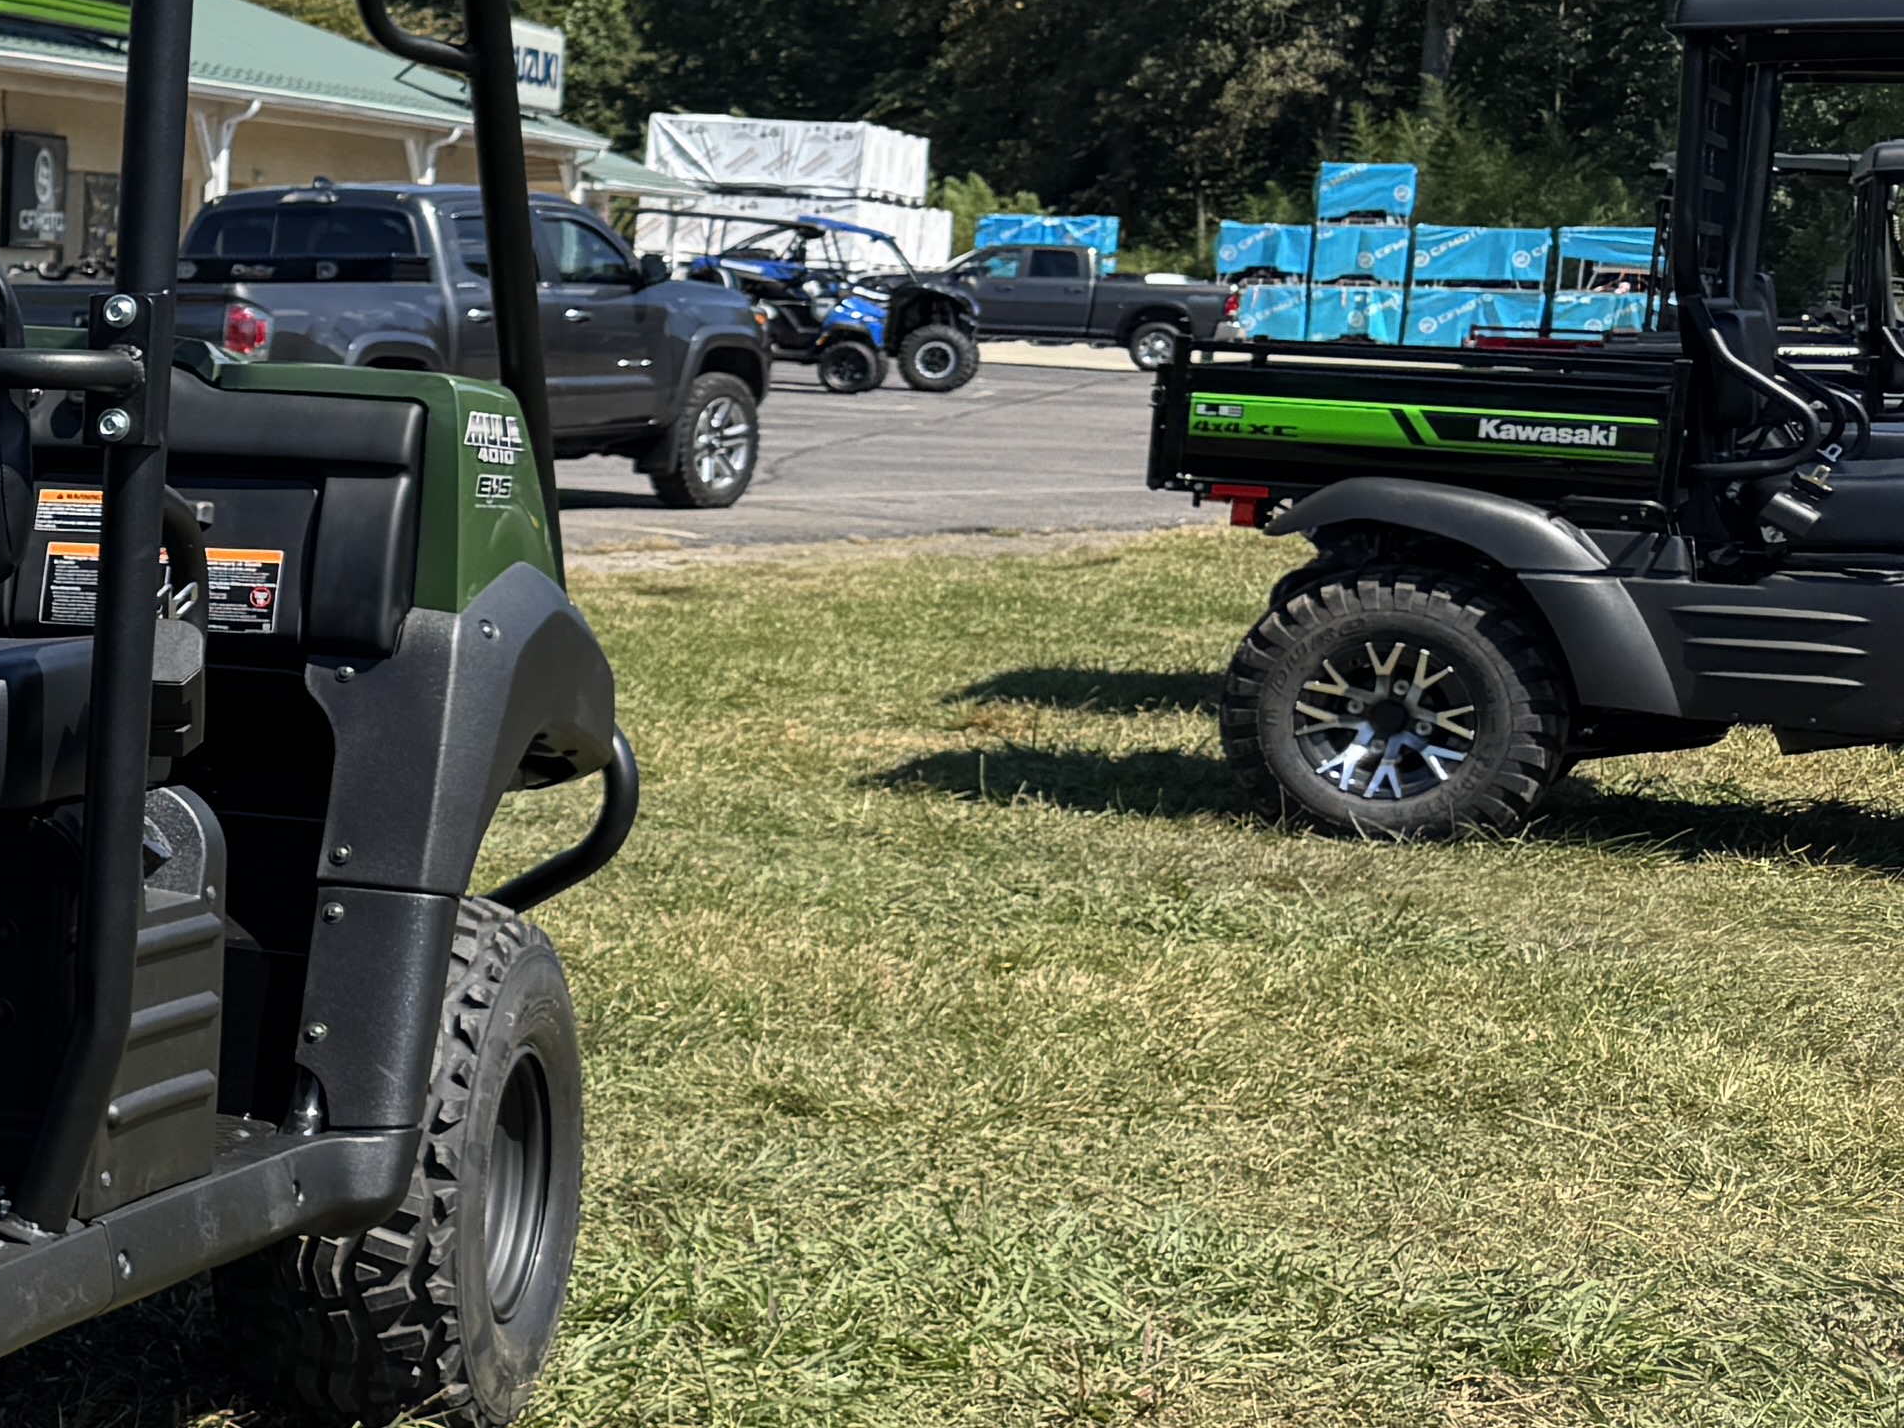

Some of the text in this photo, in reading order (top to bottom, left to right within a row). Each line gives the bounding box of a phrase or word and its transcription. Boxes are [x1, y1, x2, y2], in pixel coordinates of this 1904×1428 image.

[515, 45, 560, 89] UZUKI
[1196, 403, 1242, 418] LE
[463, 410, 523, 448] MULE
[1193, 420, 1241, 434] 4x4
[1478, 417, 1618, 447] Kawasaki
[478, 447, 515, 465] 4010
